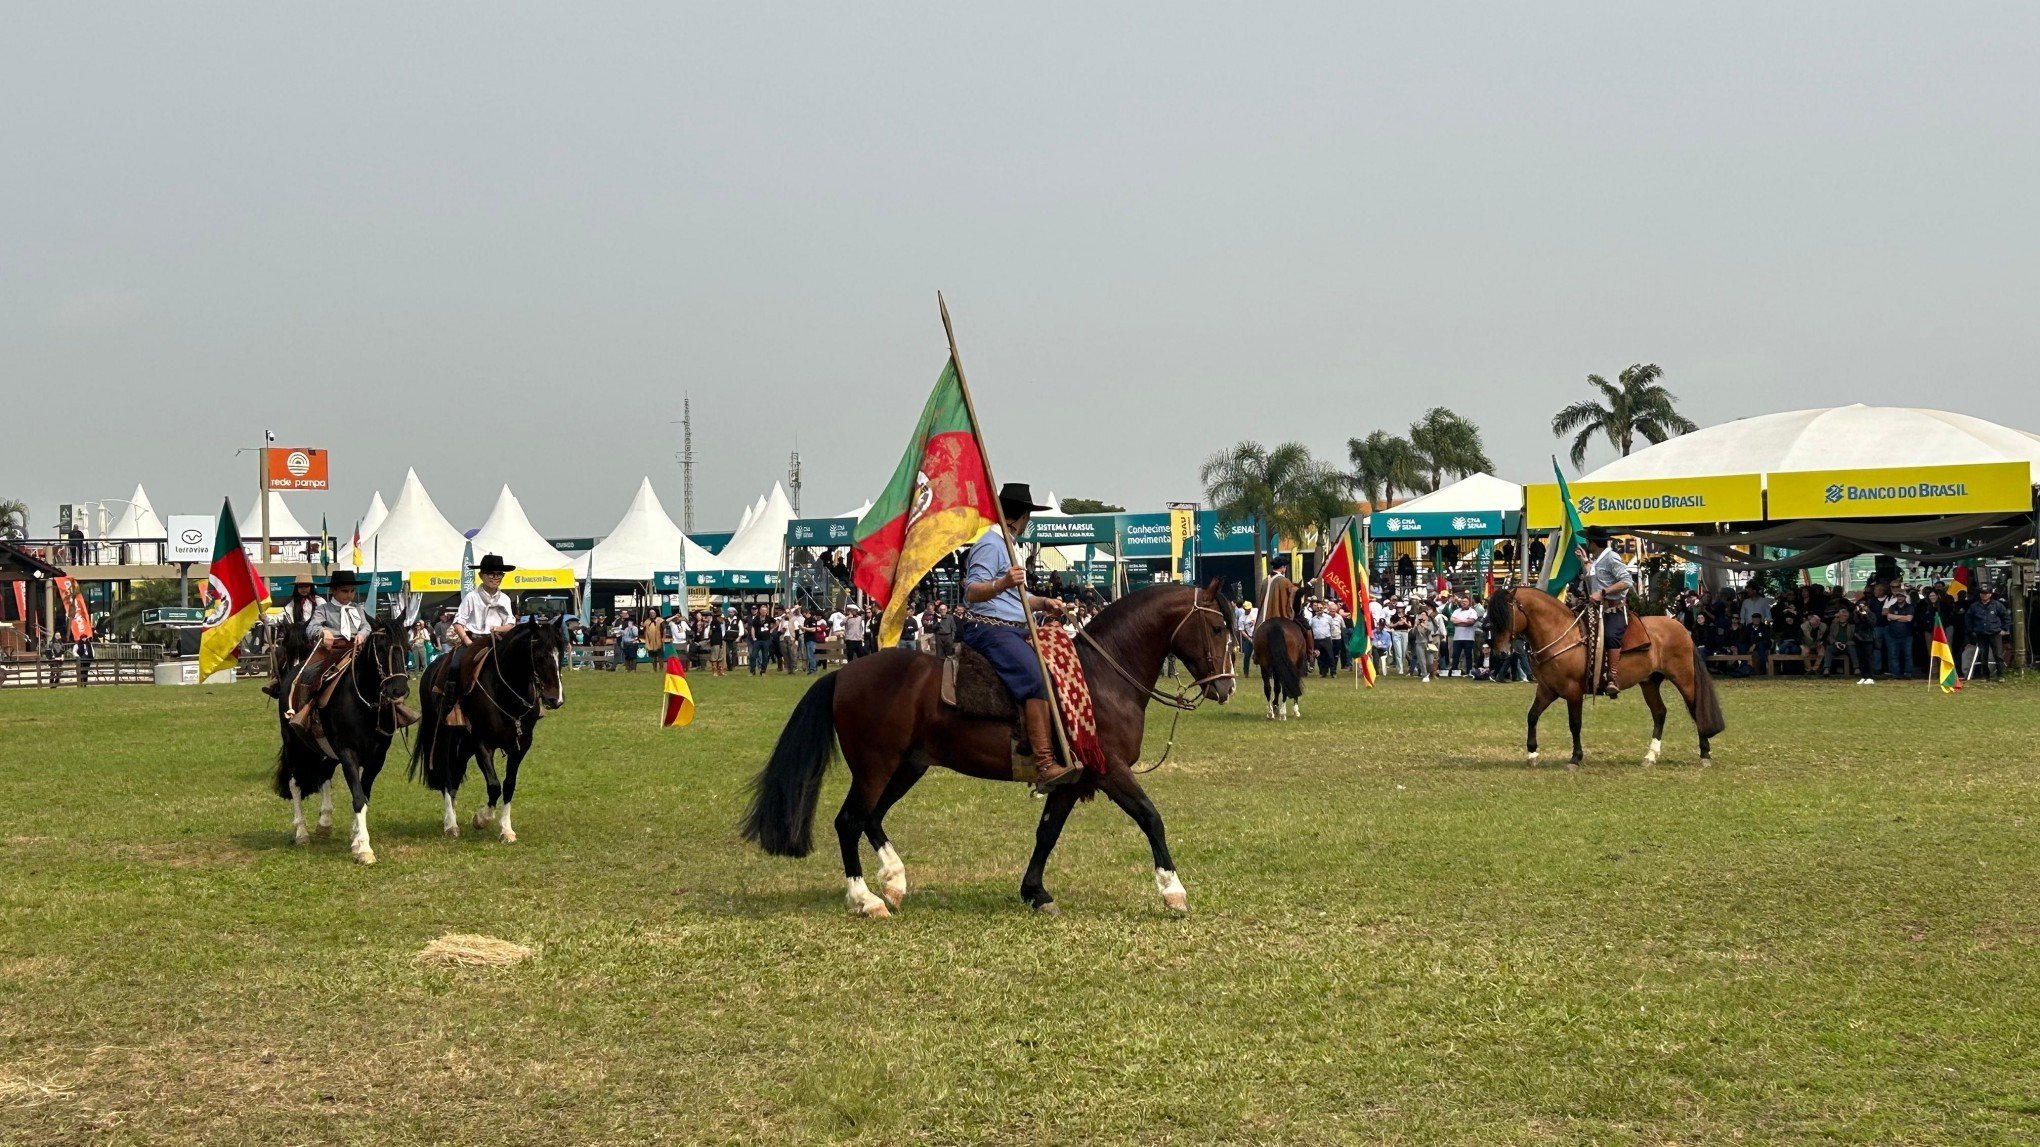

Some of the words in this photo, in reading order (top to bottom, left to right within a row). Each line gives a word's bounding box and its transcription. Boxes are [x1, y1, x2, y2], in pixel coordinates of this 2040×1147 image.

[271, 478, 291, 486] rede
[295, 480, 326, 488] pampa
[1847, 486, 1895, 500] BANCO
[1898, 486, 1917, 499] DO
[1918, 483, 1968, 498] BRASIL
[1598, 498, 1641, 511] BANCO
[1643, 498, 1660, 509] DO
[1661, 495, 1706, 508] BRASIL
[1036, 523, 1068, 531] SISTEMA
[1068, 523, 1095, 531] FARSUL
[1127, 524, 1171, 535] Conhecime
